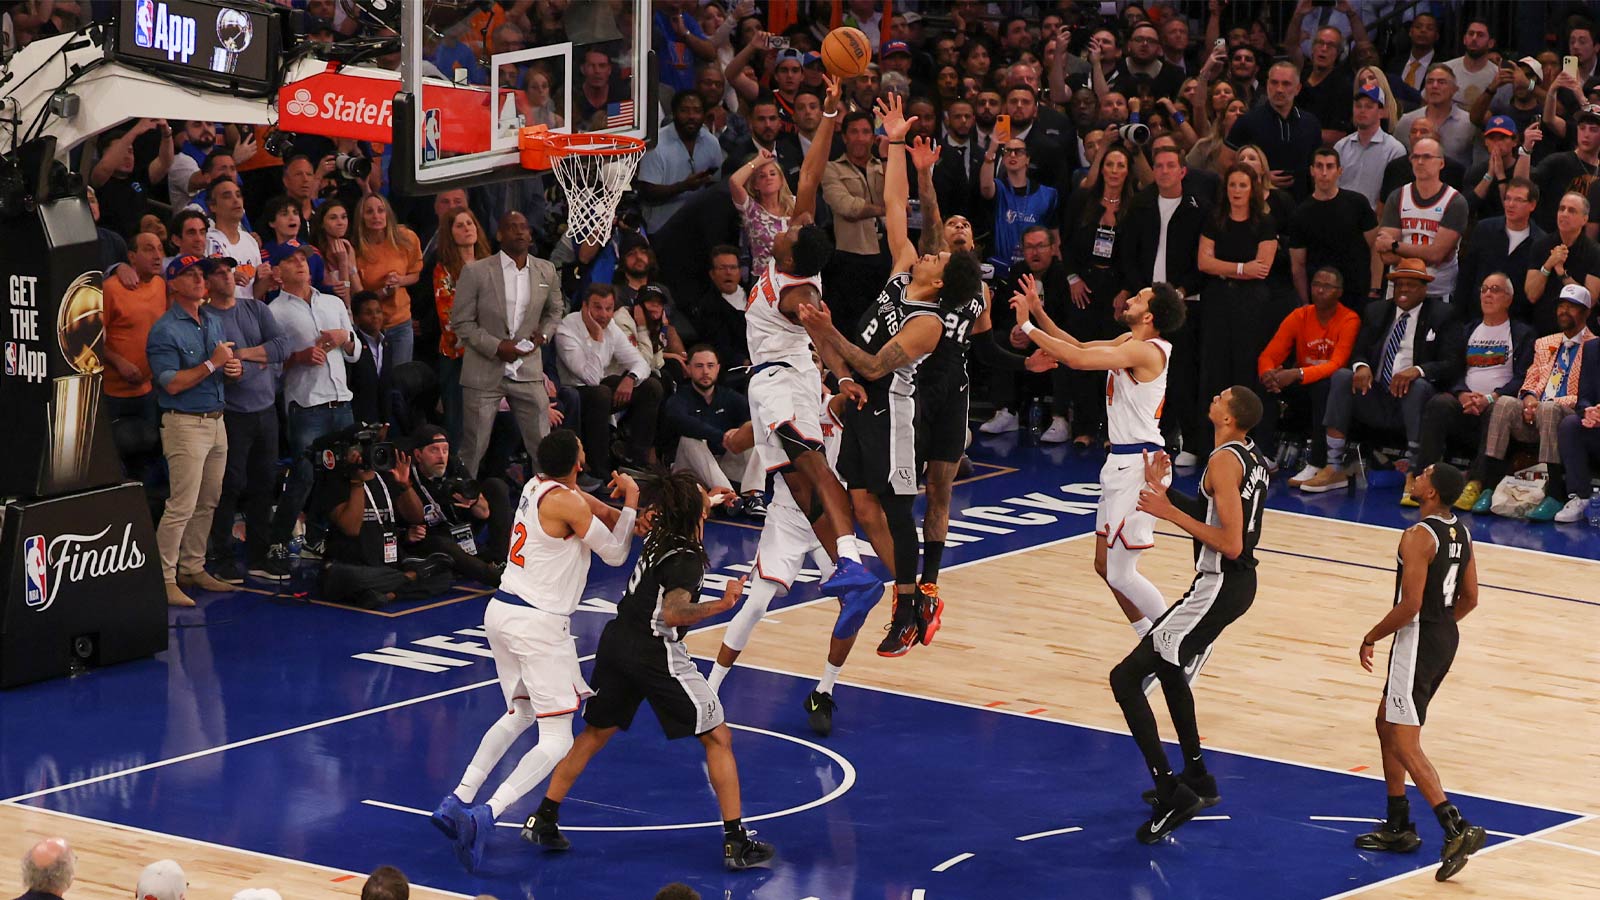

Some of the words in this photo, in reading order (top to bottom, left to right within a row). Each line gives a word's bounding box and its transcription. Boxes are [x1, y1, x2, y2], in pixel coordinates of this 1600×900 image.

[154, 3, 195, 63] App
[9, 274, 37, 306] GET
[10, 308, 39, 340] THE
[861, 318, 879, 344] 2
[945, 313, 970, 342] 24
[18, 344, 47, 383] App
[508, 522, 527, 568] 2
[36, 523, 145, 612] Finals
[1443, 563, 1459, 608] 4
[526, 816, 536, 828] 0
